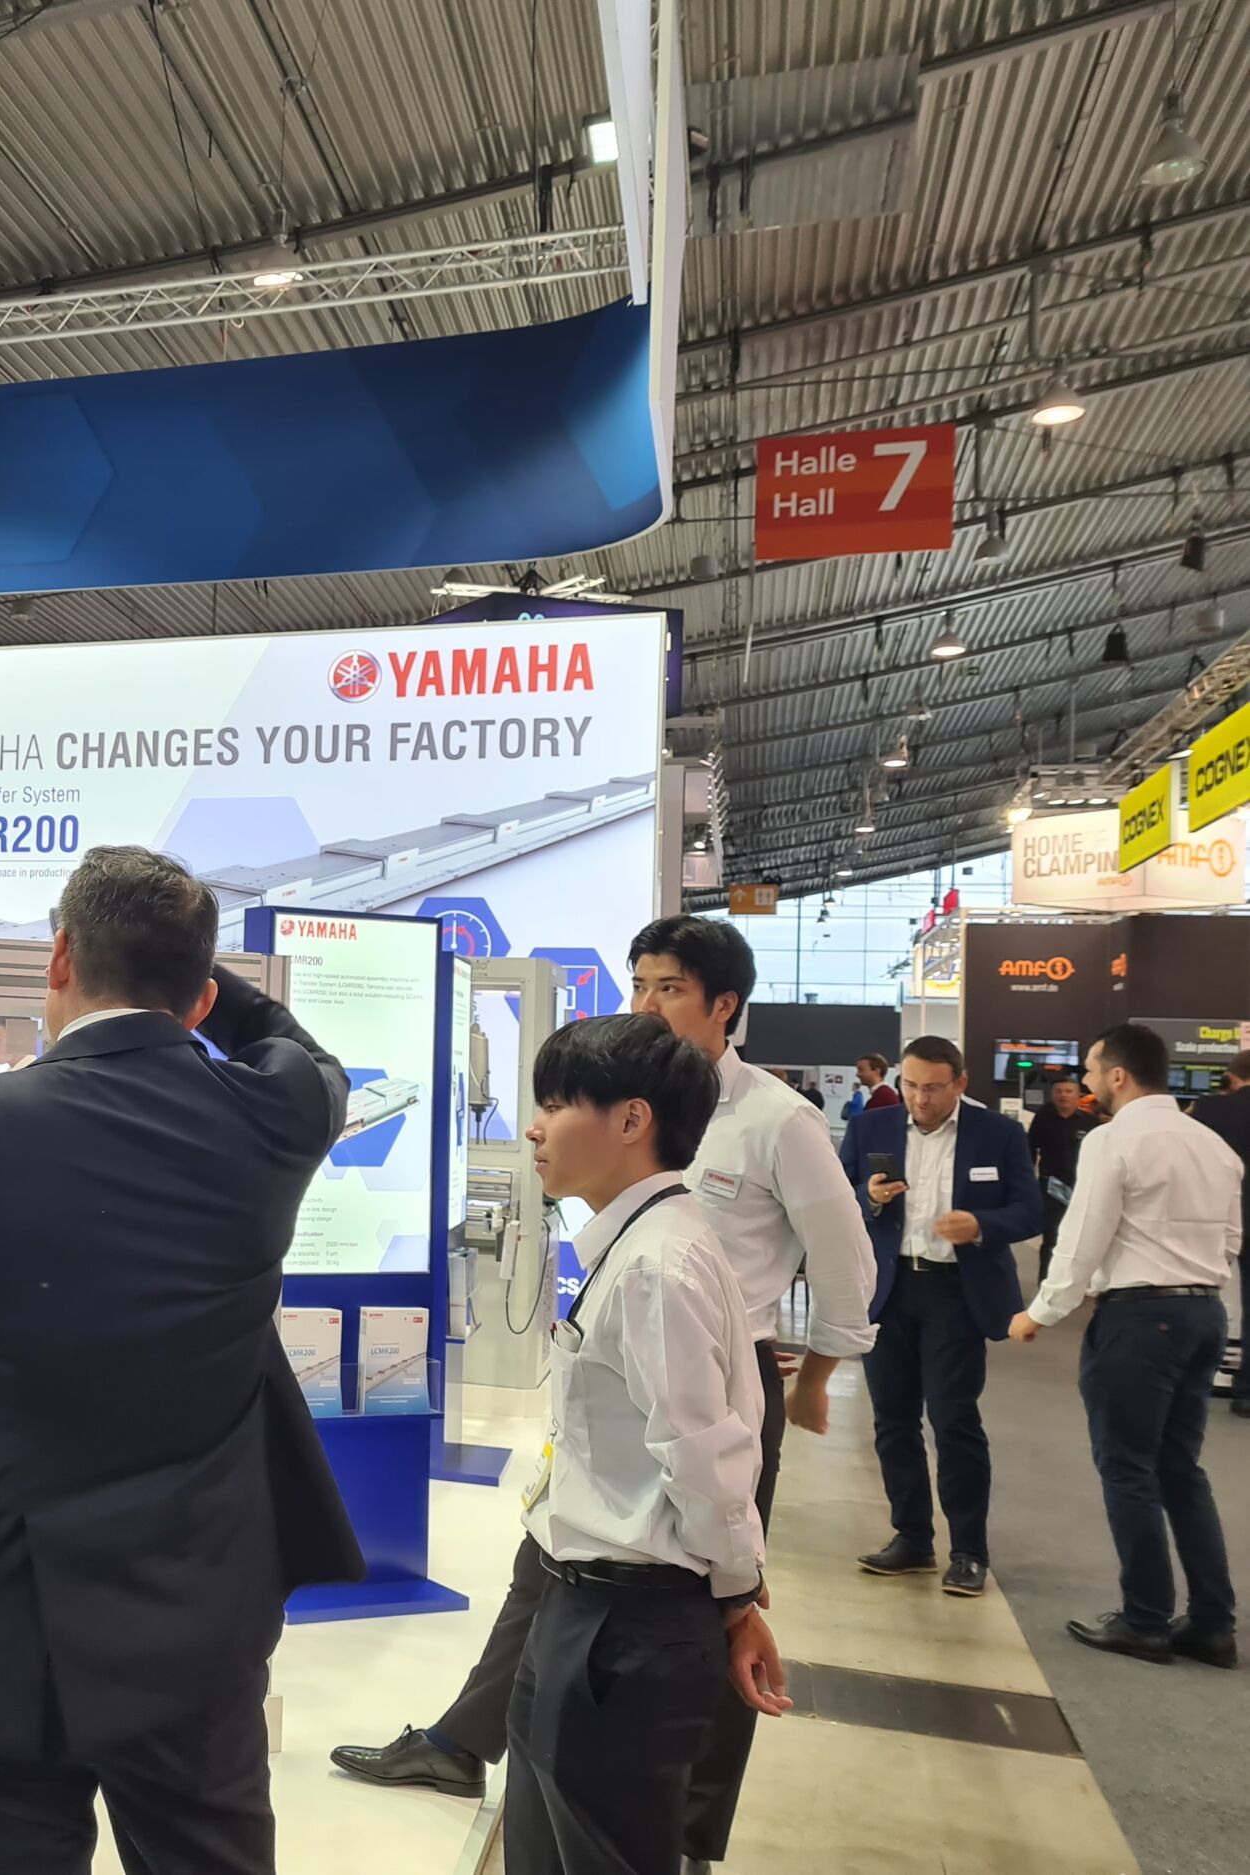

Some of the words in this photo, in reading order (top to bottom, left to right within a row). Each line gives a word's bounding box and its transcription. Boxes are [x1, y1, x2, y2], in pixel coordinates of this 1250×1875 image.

[774, 446, 858, 478] Halle
[873, 440, 928, 512] 7
[773, 488, 835, 519] Hall
[388, 643, 594, 698] YAMAHA
[56, 726, 240, 770] CHANGES
[255, 723, 372, 765] YOUR
[389, 716, 593, 762] FACTORY
[22, 786, 80, 806] System
[1123, 794, 1166, 845] COGNEX
[1024, 832, 1083, 858] HOME
[19, 867, 27, 878] in
[29, 867, 71, 880] productio
[1024, 851, 1120, 878] CLAMPIN
[297, 920, 358, 941] YAMAHA
[291, 955, 323, 966] MR200
[557, 1276, 580, 1296] CS
[370, 1347, 400, 1356] LCMR200
